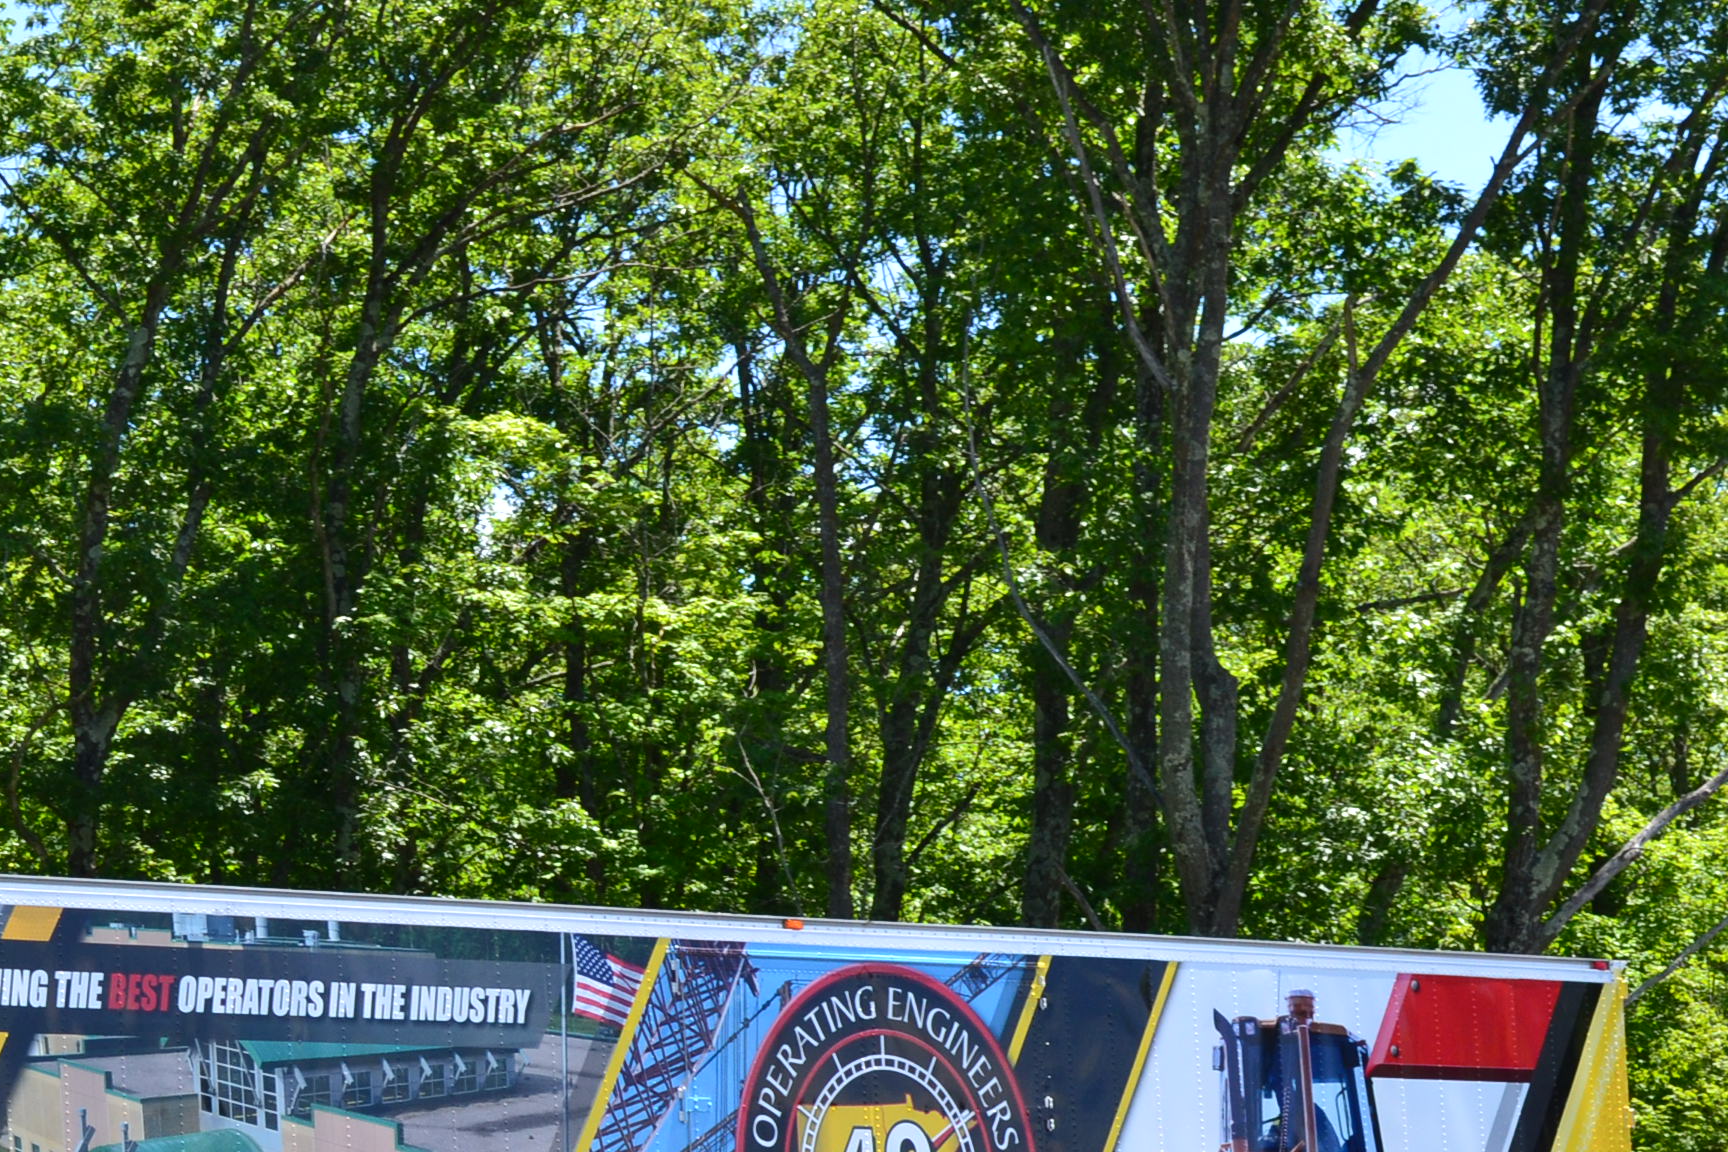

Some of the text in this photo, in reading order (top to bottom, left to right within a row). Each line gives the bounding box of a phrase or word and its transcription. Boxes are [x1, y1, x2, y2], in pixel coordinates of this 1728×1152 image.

[54, 970, 105, 1010] THE
[108, 972, 176, 1012] BEST
[177, 975, 325, 1018] OPERATORS
[328, 981, 357, 1019] IN
[361, 983, 407, 1021] THE
[410, 985, 532, 1025] INDUSTRY
[751, 984, 1021, 1152] OPERATING ENGINEERS
